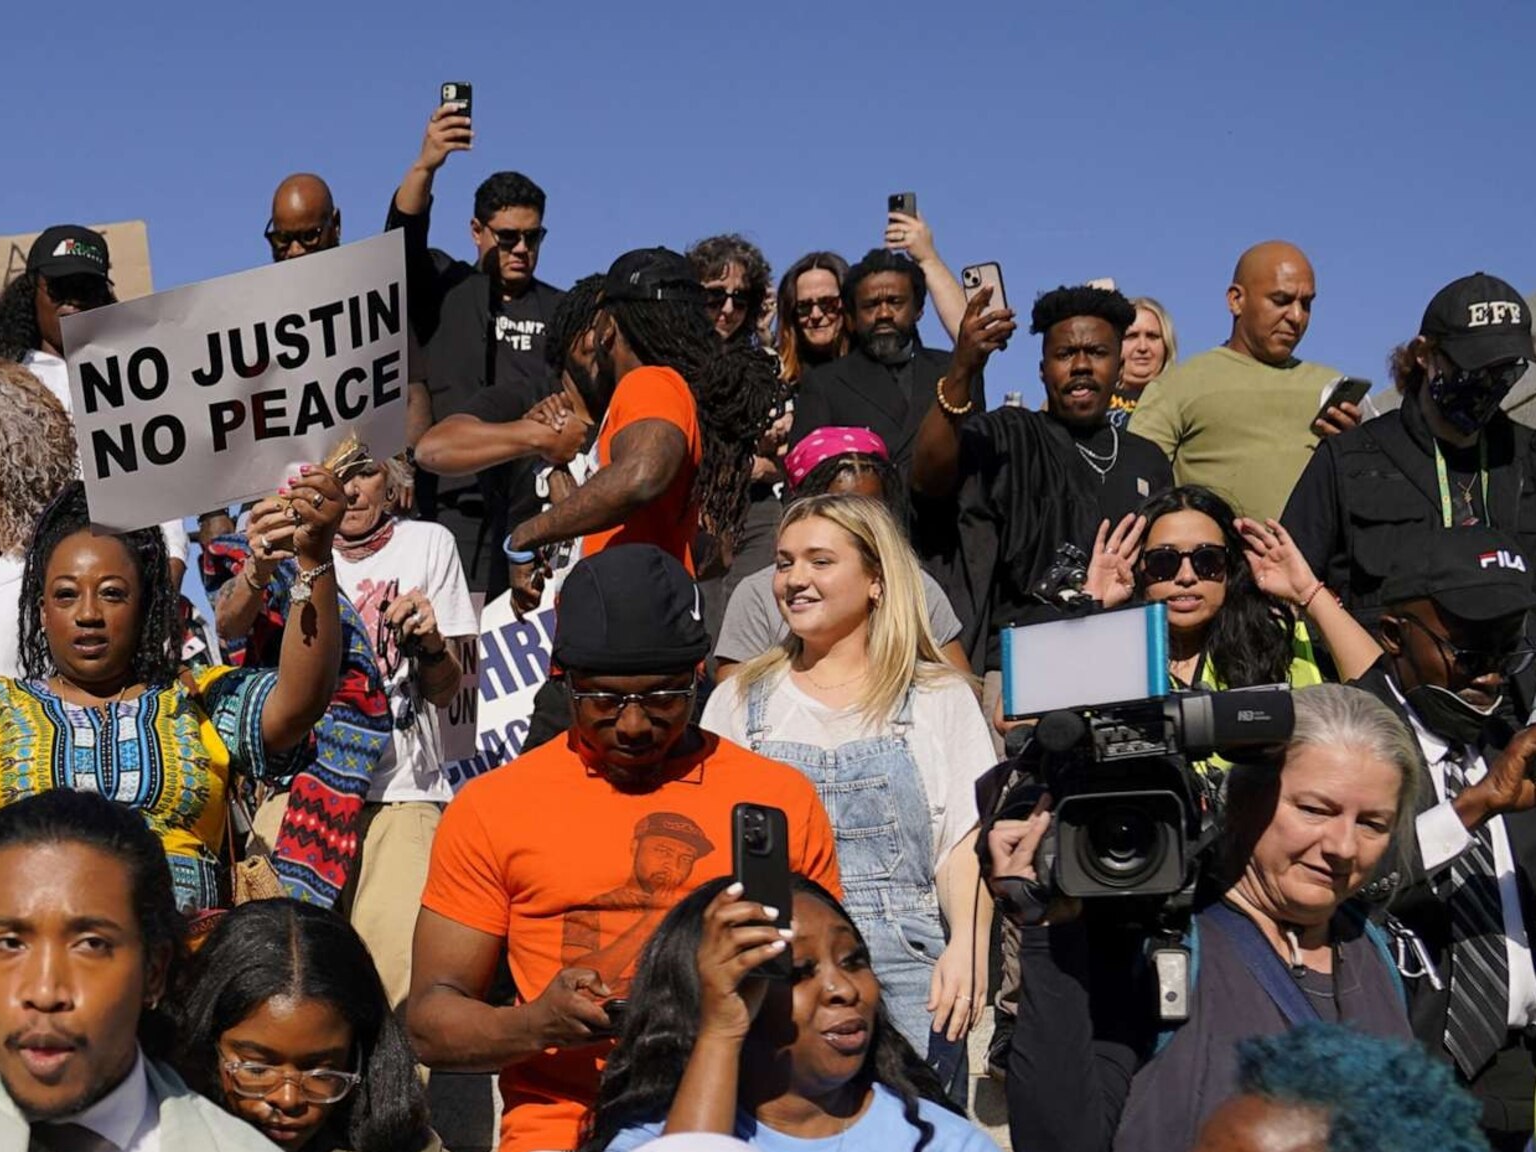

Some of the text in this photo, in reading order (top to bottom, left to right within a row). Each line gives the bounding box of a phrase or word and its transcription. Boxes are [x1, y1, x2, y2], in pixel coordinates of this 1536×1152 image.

[79, 281, 402, 414] NO JUSTIN
[495, 323, 532, 351] VTE
[91, 350, 402, 480] NO PEACE
[1479, 550, 1526, 572] FILA
